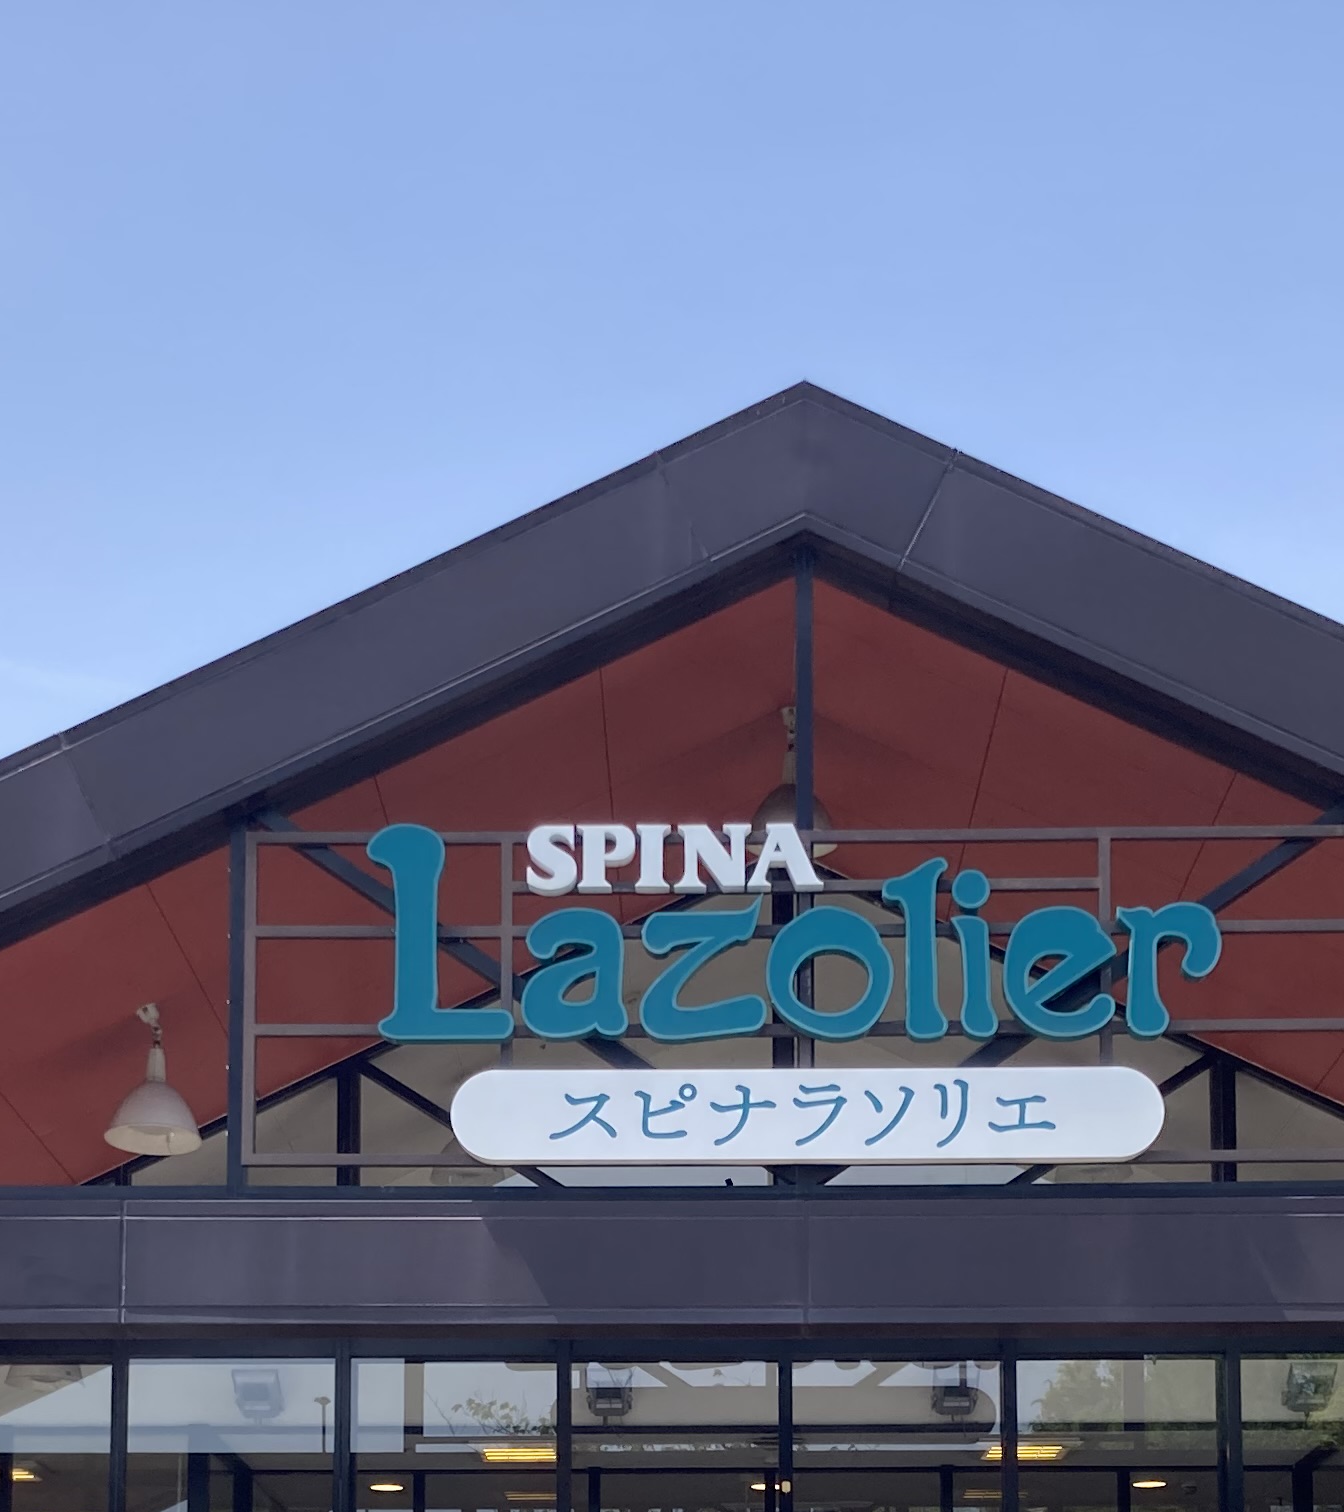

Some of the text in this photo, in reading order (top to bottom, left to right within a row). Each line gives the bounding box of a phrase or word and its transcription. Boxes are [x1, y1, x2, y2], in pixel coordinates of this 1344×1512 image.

[526, 822, 824, 896] SPINA
[366, 823, 1223, 1043] Lazolier
[548, 1080, 1058, 1148] スピナラソリエ
